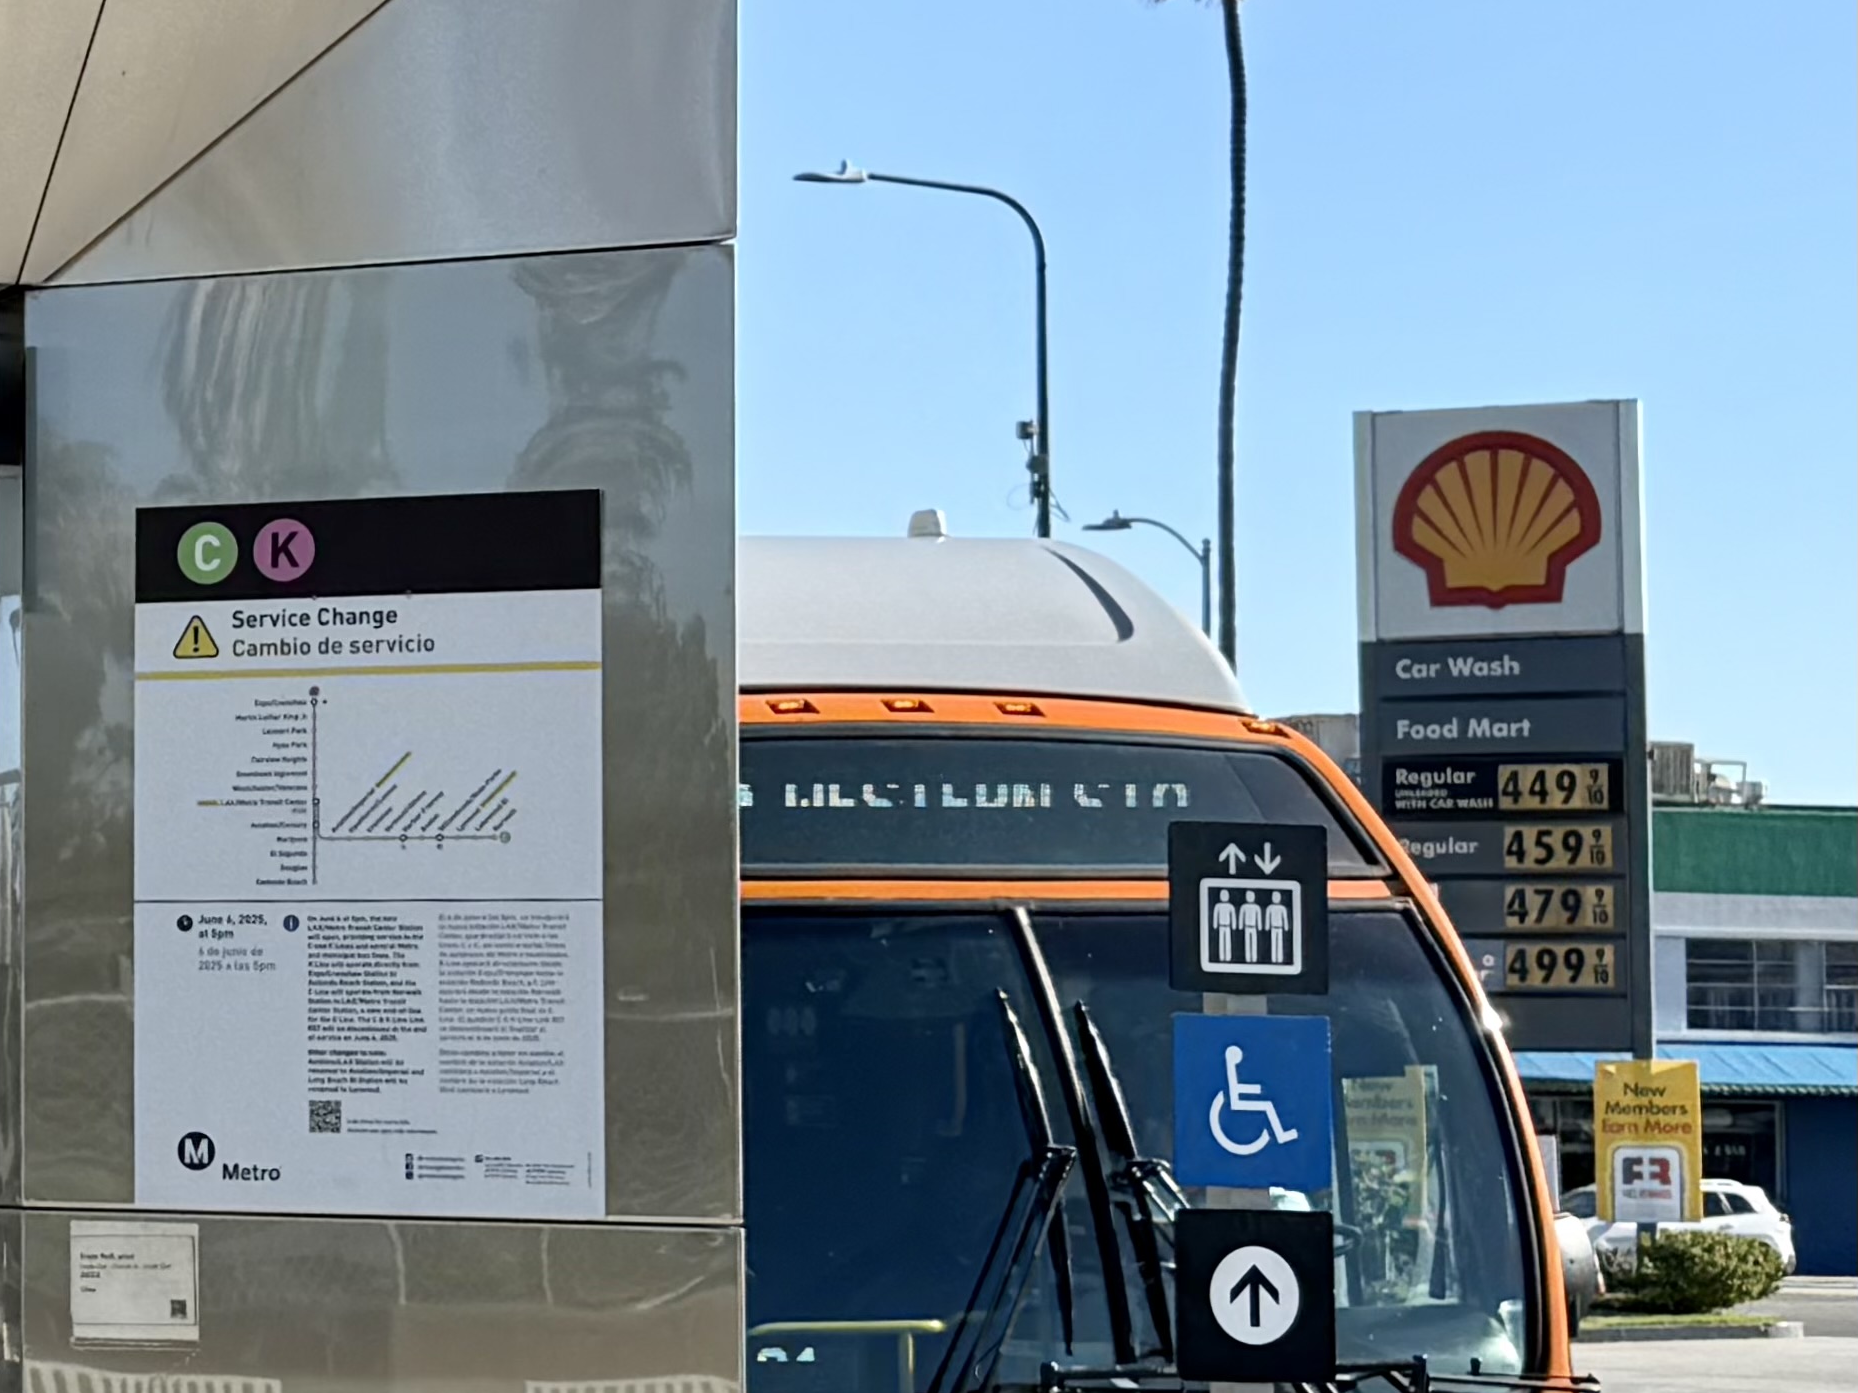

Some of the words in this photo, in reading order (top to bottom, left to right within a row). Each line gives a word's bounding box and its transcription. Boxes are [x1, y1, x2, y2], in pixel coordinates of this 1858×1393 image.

[194, 534, 221, 571] C
[270, 531, 299, 568] K
[232, 610, 311, 628] Service
[317, 607, 398, 628] Change
[232, 637, 311, 657] Cambio
[318, 637, 343, 654] de
[349, 634, 436, 654] servicio
[1395, 658, 1442, 679] Car
[1448, 655, 1521, 677] Wash
[1396, 718, 1459, 740] Food
[1466, 717, 1532, 739] Mart
[1395, 767, 1477, 788] Regular
[198, 914, 223, 925] June
[1623, 1082, 1668, 1099] New
[1604, 1100, 1689, 1117] Members
[1601, 1118, 1639, 1135] Earn
[1644, 1118, 1694, 1135] More
[222, 1162, 281, 1182] Metro
